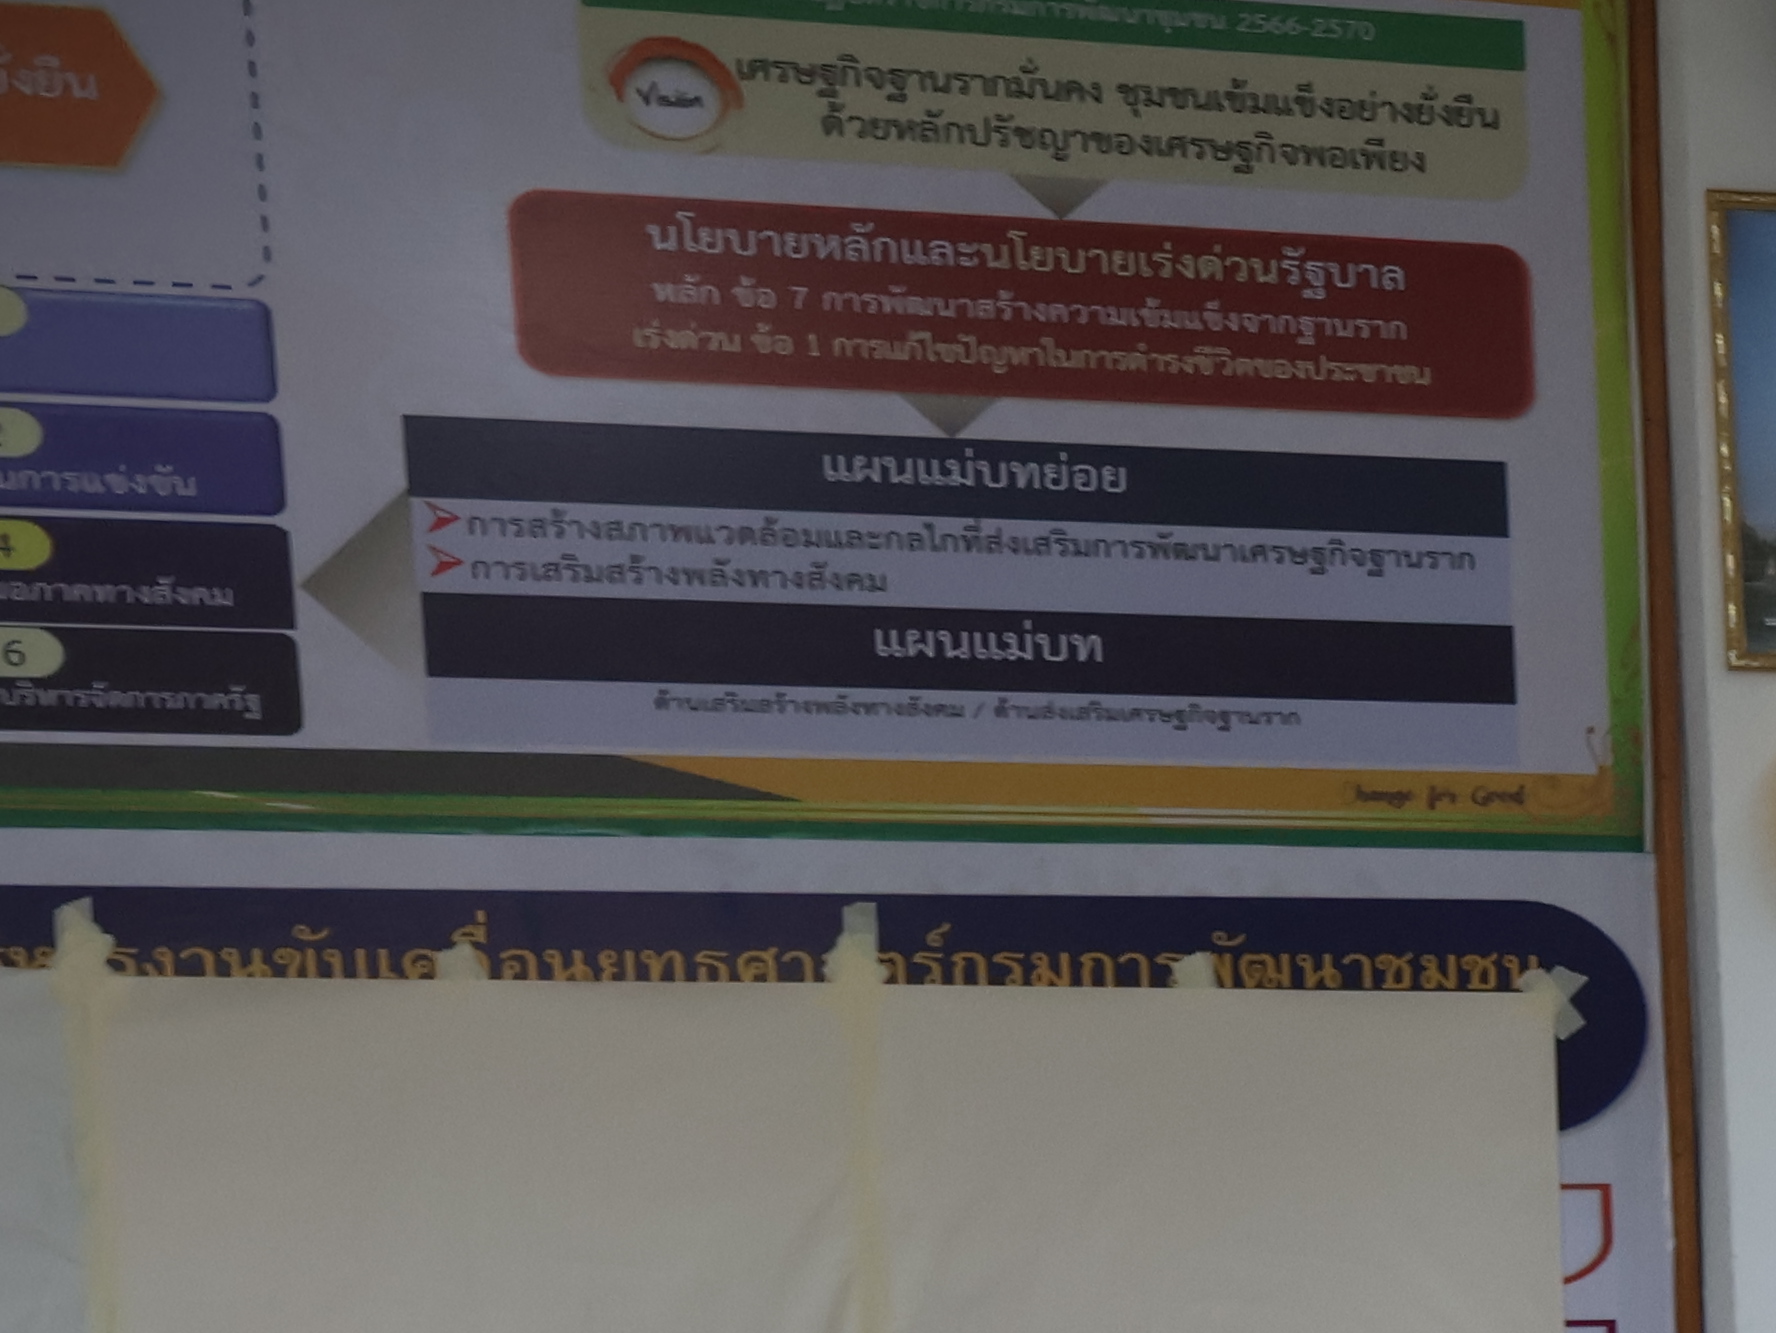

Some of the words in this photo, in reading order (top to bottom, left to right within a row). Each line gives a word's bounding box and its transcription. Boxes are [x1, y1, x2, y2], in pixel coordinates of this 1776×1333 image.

[1235, 12, 1376, 42] 2566-2570
[645, 211, 1407, 300] นโยบายหลักและนโยบายเร่งด่วนรัฐบาล
[788, 286, 809, 311] 7
[806, 333, 821, 358] 1
[822, 447, 1128, 495] แผนแม่บทย่อย
[5, 640, 25, 666] 6
[873, 620, 1104, 664] แผนแม่บท
